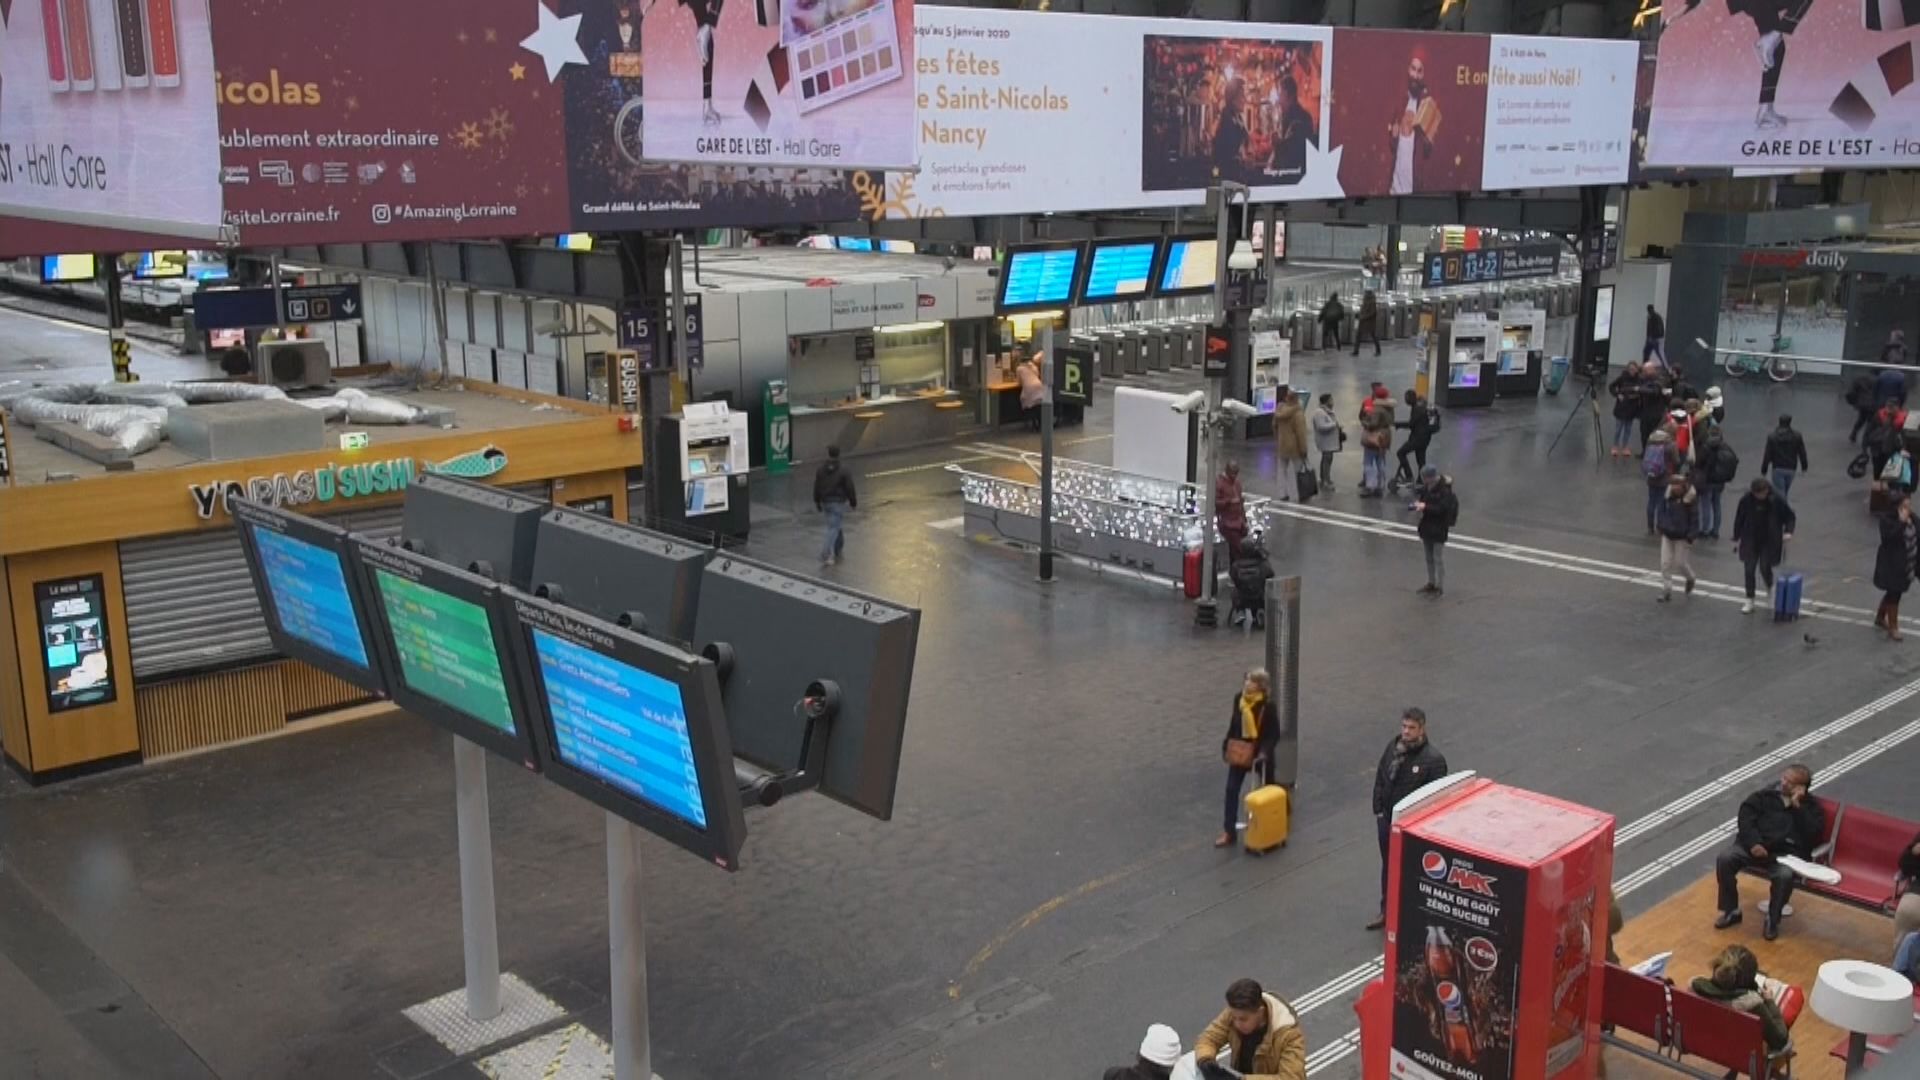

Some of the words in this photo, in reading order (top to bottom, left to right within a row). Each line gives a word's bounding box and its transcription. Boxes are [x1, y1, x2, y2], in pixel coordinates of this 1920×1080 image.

[946, 25, 951, 37] 5
[953, 24, 984, 39] janvier
[987, 29, 1010, 39] 2020
[916, 56, 939, 74] es
[946, 48, 1000, 76] fêtes
[1456, 65, 1469, 85] Et
[1473, 71, 1488, 85] on
[1491, 65, 1515, 86] fête
[1518, 68, 1546, 86] aussi
[1550, 68, 1576, 87] Noël
[936, 84, 1068, 110] Saint-Nicolas
[219, 129, 311, 148] ublement
[316, 128, 439, 147] extraordinaire
[922, 120, 986, 150] Nancy
[696, 137, 726, 154] GARE
[729, 138, 743, 154] DE
[747, 138, 772, 155] L'EST
[784, 139, 806, 156] Hall
[809, 140, 841, 158] Gare
[1741, 140, 1792, 157] GARE
[1799, 140, 1822, 155] DE
[1828, 139, 1873, 155] L'EST
[26, 143, 58, 187] Hall
[61, 144, 107, 191] Gare
[932, 161, 979, 176] Spectacles
[981, 161, 1027, 176] grandioses
[943, 181, 983, 192] émotions
[985, 180, 1011, 191] fortes
[394, 202, 517, 224] #AmazingLorraine
[583, 203, 610, 213] Grand
[611, 202, 635, 213] défilé
[637, 202, 647, 212] de
[649, 200, 701, 212] Saint-Nicolas
[1466, 261, 1477, 279] 13
[1485, 259, 1497, 277] 22
[1806, 250, 1848, 272] daily
[627, 318, 648, 338] 15
[621, 357, 637, 403] SUSHI
[314, 457, 415, 502] D'SUSHI
[1419, 882, 1432, 895] UN
[1433, 887, 1455, 904] MAX
[1456, 896, 1470, 908] DE
[1470, 901, 1500, 917] GOÛT
[1426, 897, 1451, 914] ZÉRO
[1452, 906, 1490, 926] SUCRES
